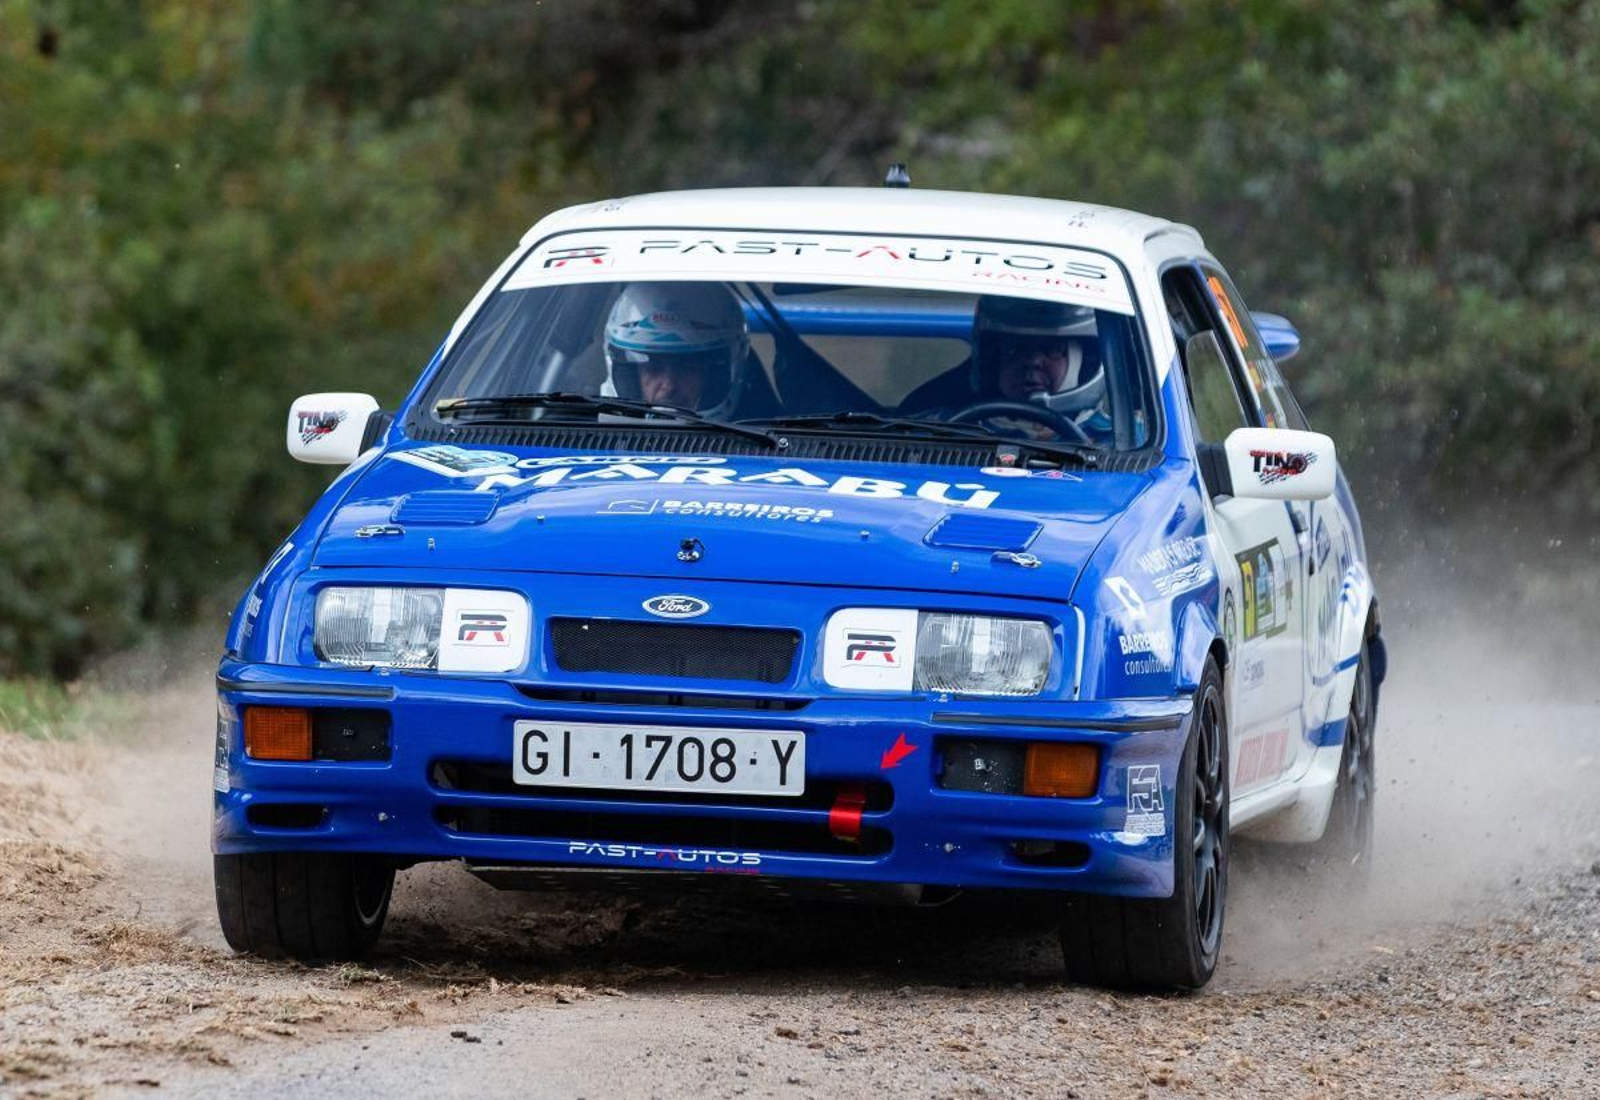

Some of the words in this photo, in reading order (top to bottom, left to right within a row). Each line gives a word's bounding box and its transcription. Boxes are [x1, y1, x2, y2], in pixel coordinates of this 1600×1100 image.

[640, 240, 1107, 279] FAST-AUTOS
[662, 500, 834, 518] BARREIROS
[664, 507, 822, 524] consultores
[569, 841, 762, 865] FAST-AUTOS
